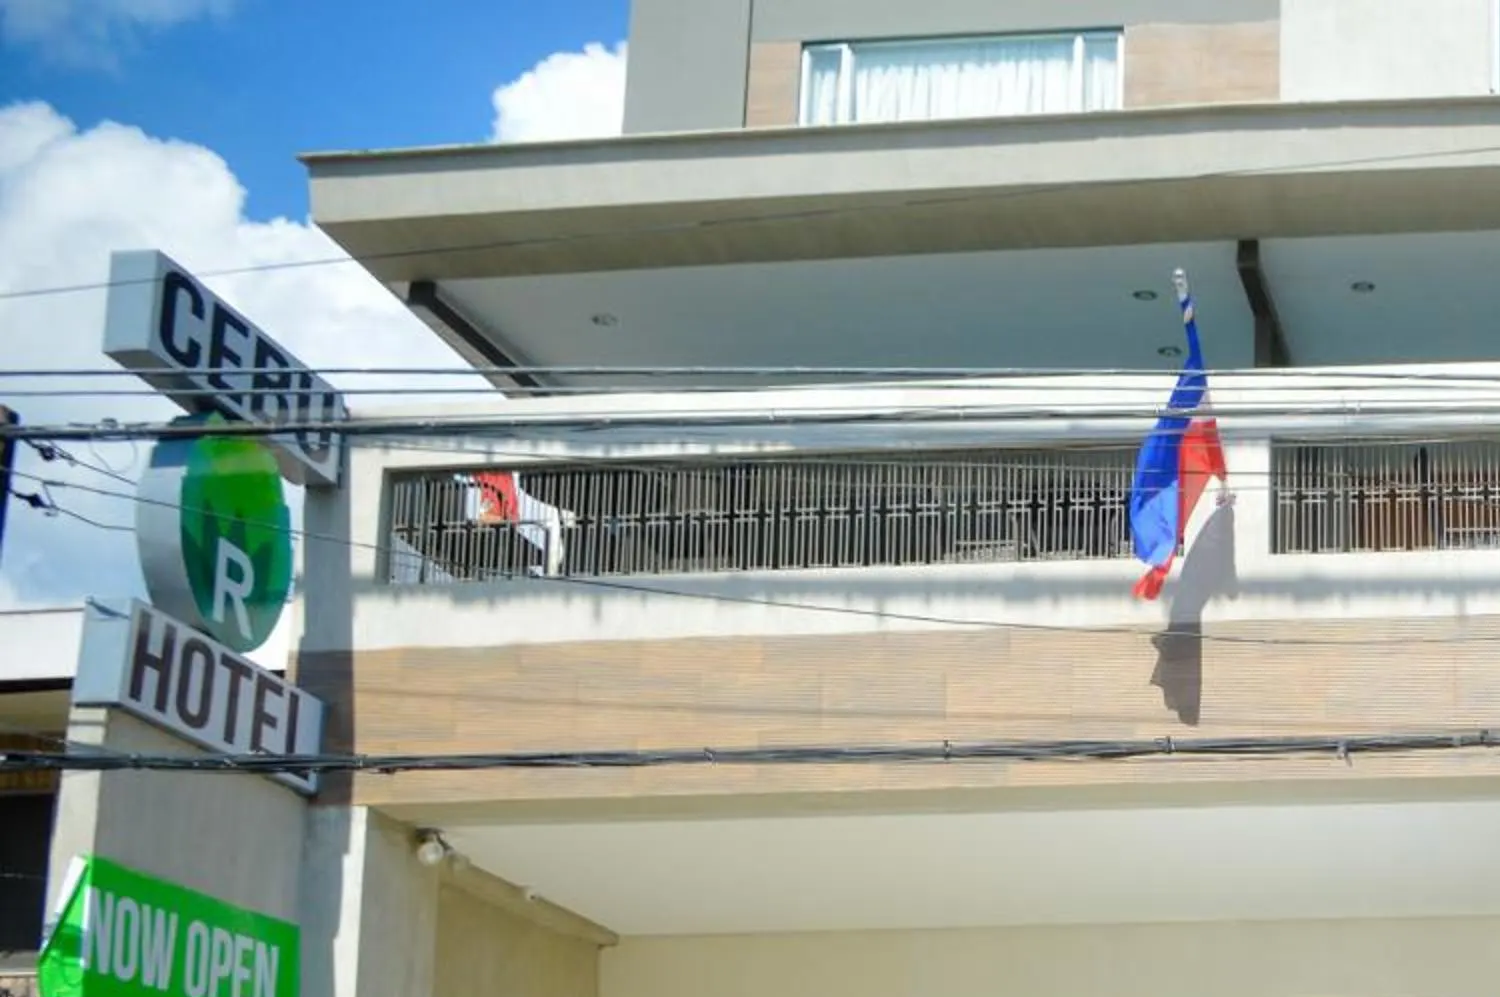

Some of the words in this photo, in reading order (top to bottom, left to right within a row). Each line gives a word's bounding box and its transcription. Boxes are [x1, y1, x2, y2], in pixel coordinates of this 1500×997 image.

[159, 270, 336, 455] CEBU
[213, 537, 255, 640] R
[127, 607, 316, 790] HOTEL
[83, 886, 178, 990] NOW
